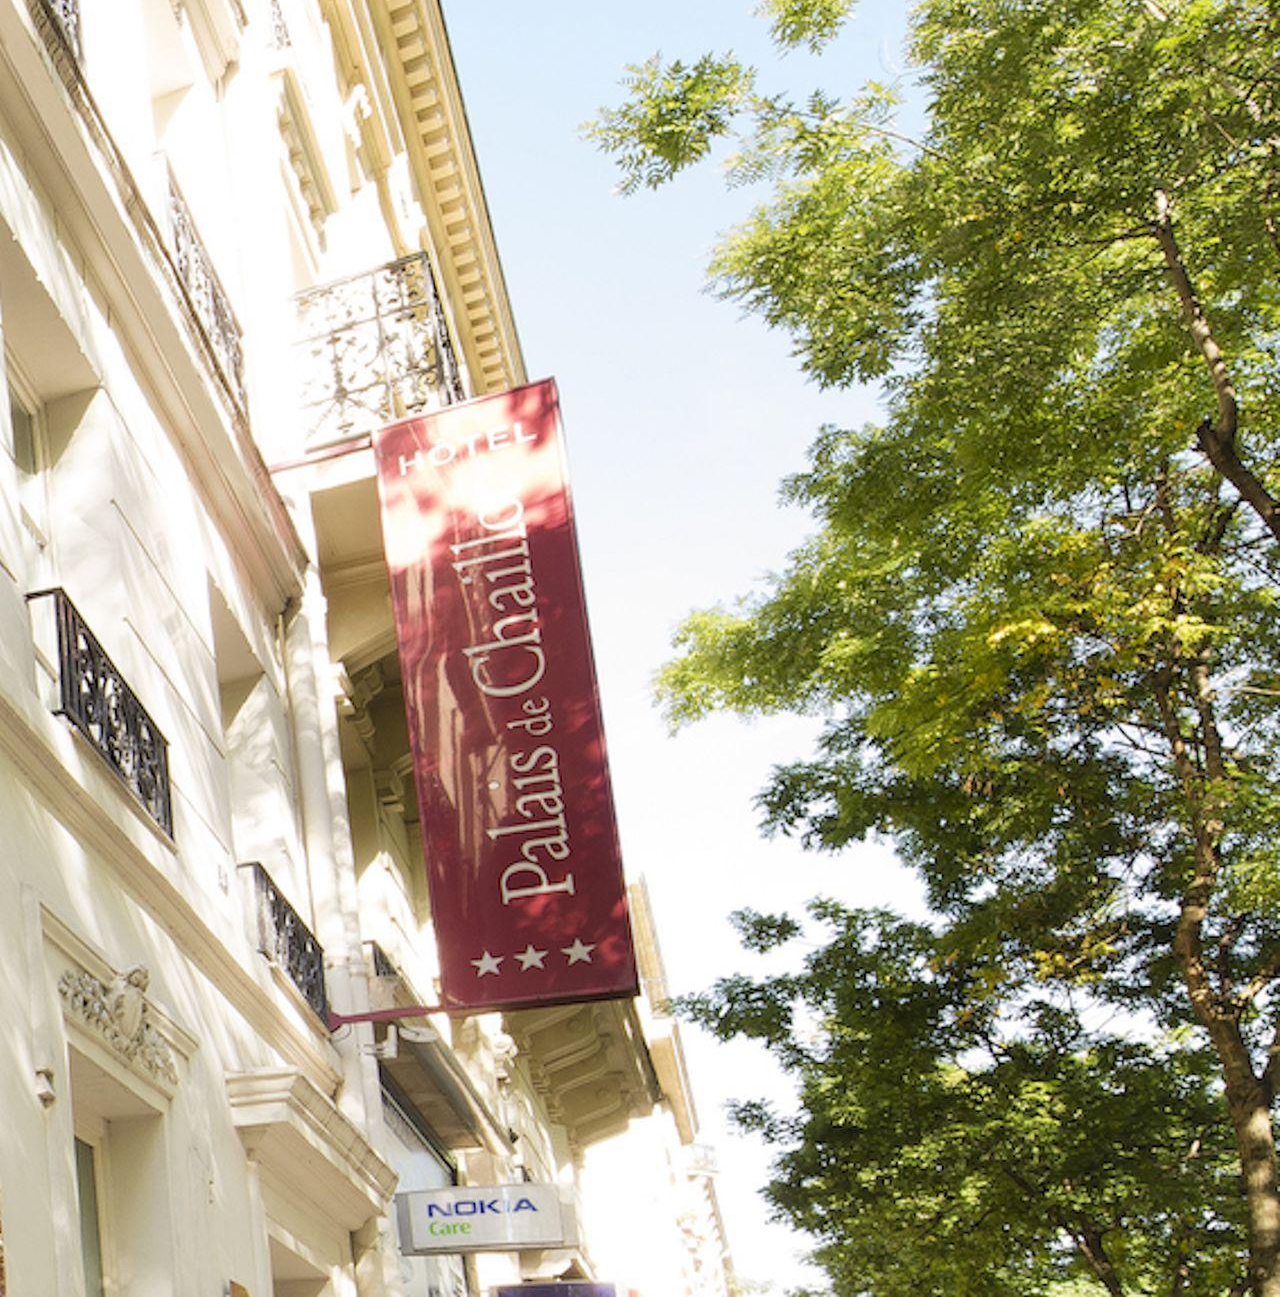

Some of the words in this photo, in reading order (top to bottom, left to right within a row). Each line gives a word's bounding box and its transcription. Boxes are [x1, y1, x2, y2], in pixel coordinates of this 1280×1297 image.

[449, 487, 548, 698] Chaillo
[507, 696, 555, 736] de
[486, 744, 576, 906] Palais
[428, 1221, 472, 1237] Care
